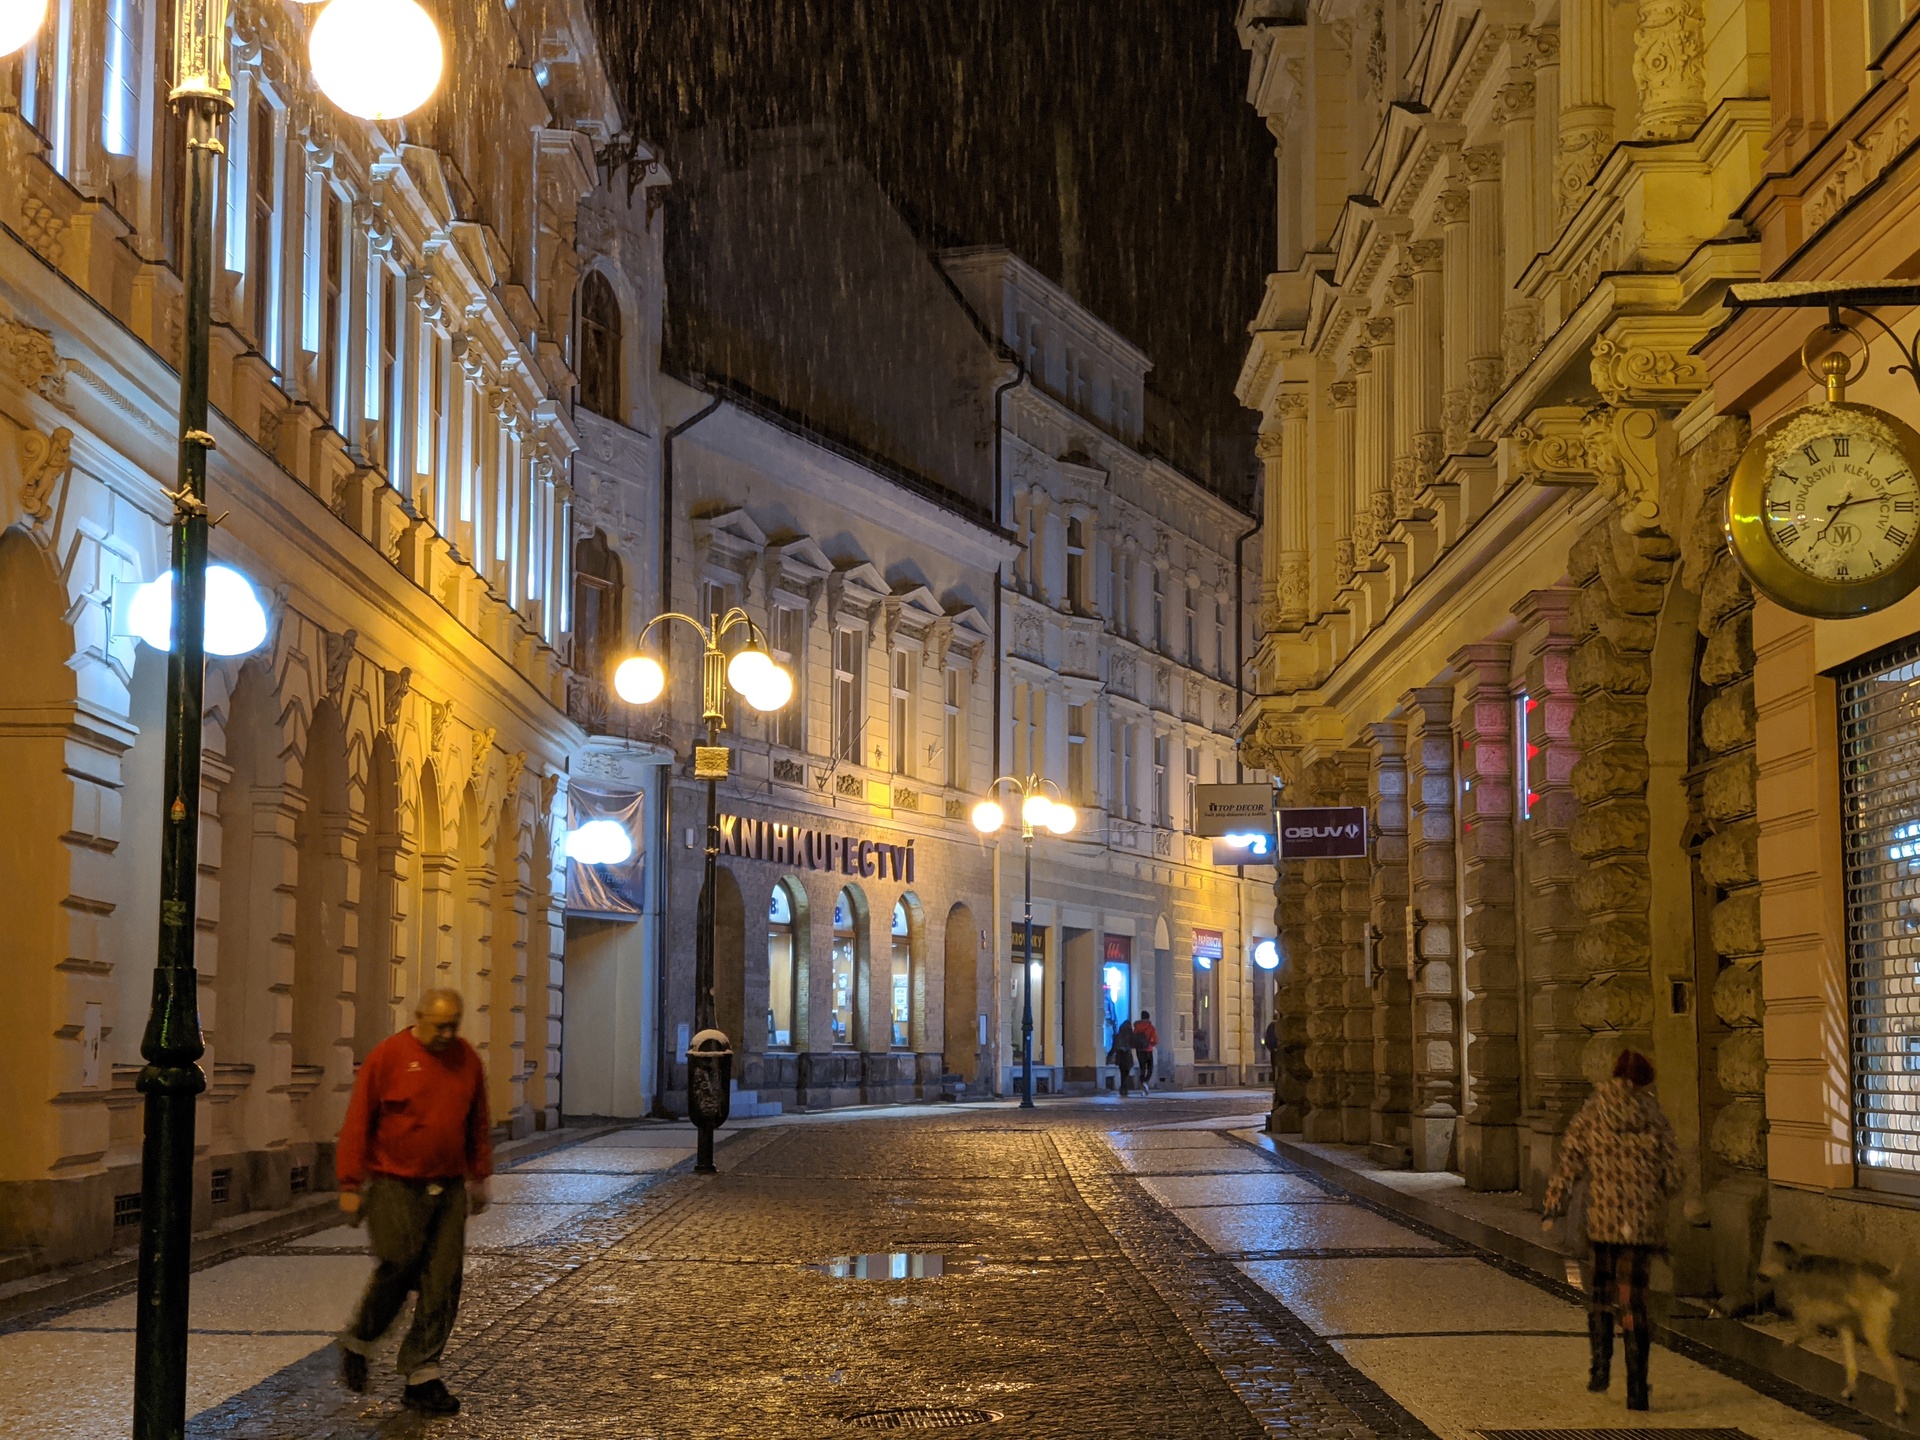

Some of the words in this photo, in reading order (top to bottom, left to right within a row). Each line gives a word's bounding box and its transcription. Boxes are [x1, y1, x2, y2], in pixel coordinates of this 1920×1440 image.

[1833, 438, 1849, 457] XII
[1894, 501, 1914, 513] III
[1236, 803, 1264, 811] DECOR
[1285, 826, 1343, 839] OBUV
[719, 813, 914, 883] KNIHKUPECTVÍ
